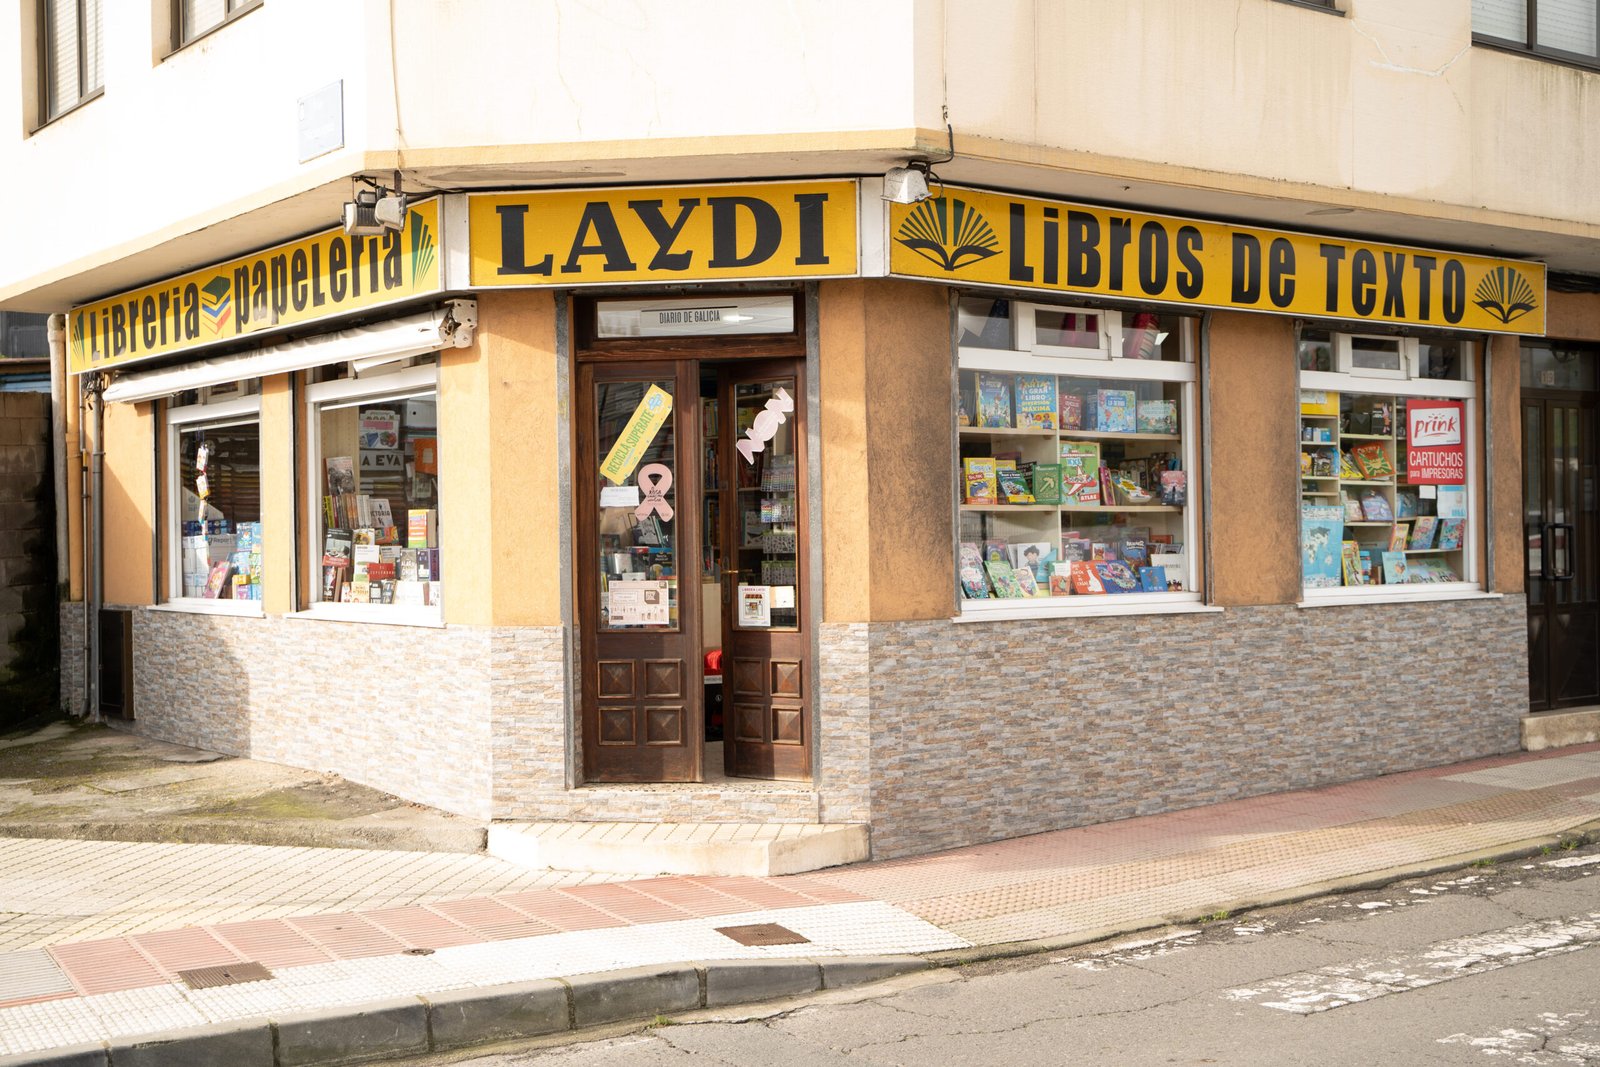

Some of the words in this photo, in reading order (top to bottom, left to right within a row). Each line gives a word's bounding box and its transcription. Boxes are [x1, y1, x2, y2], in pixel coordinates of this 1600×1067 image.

[496, 193, 830, 277] LAYDI
[659, 311, 682, 324] DIARIO
[683, 311, 693, 323] DE
[694, 310, 721, 323] GALICIA
[1414, 415, 1457, 438] prink
[375, 454, 401, 466] EVA
[606, 443, 632, 475] RECICLA
[1410, 451, 1463, 467] CARTUCHOS
[1410, 470, 1420, 478] para
[1422, 468, 1463, 479] IMPRESORAS
